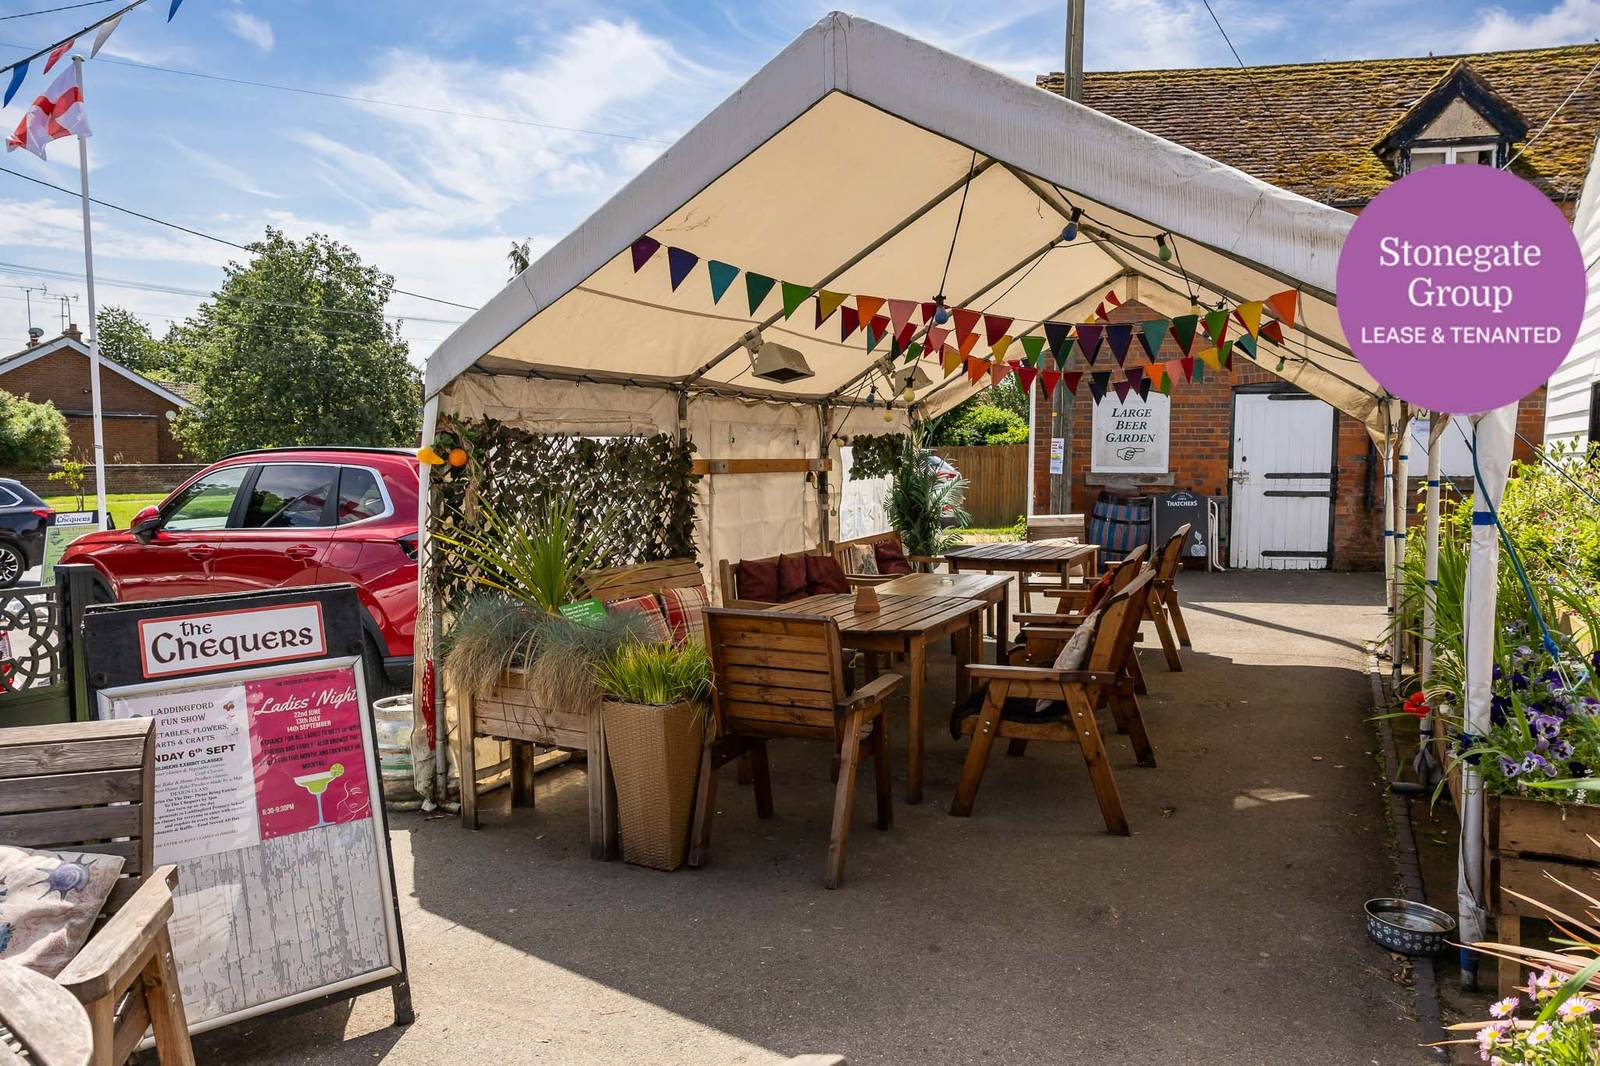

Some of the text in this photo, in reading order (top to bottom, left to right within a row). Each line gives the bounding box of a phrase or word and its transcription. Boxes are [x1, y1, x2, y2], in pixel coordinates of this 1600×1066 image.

[1111, 407, 1152, 418] LARGE
[1116, 420, 1148, 430] BEER
[1105, 432, 1156, 443] GARDEN
[179, 621, 213, 637] the
[254, 686, 357, 715] Ladies' Night
[150, 702, 214, 716] LADDINGFORD
[308, 708, 321, 716] JUNE
[161, 713, 206, 726] FUN SHOW
[300, 720, 332, 731] SEPTEMBER
[186, 735, 216, 744] CRAFTS
[188, 748, 202, 758] 6th
[206, 744, 236, 755] SEPT
